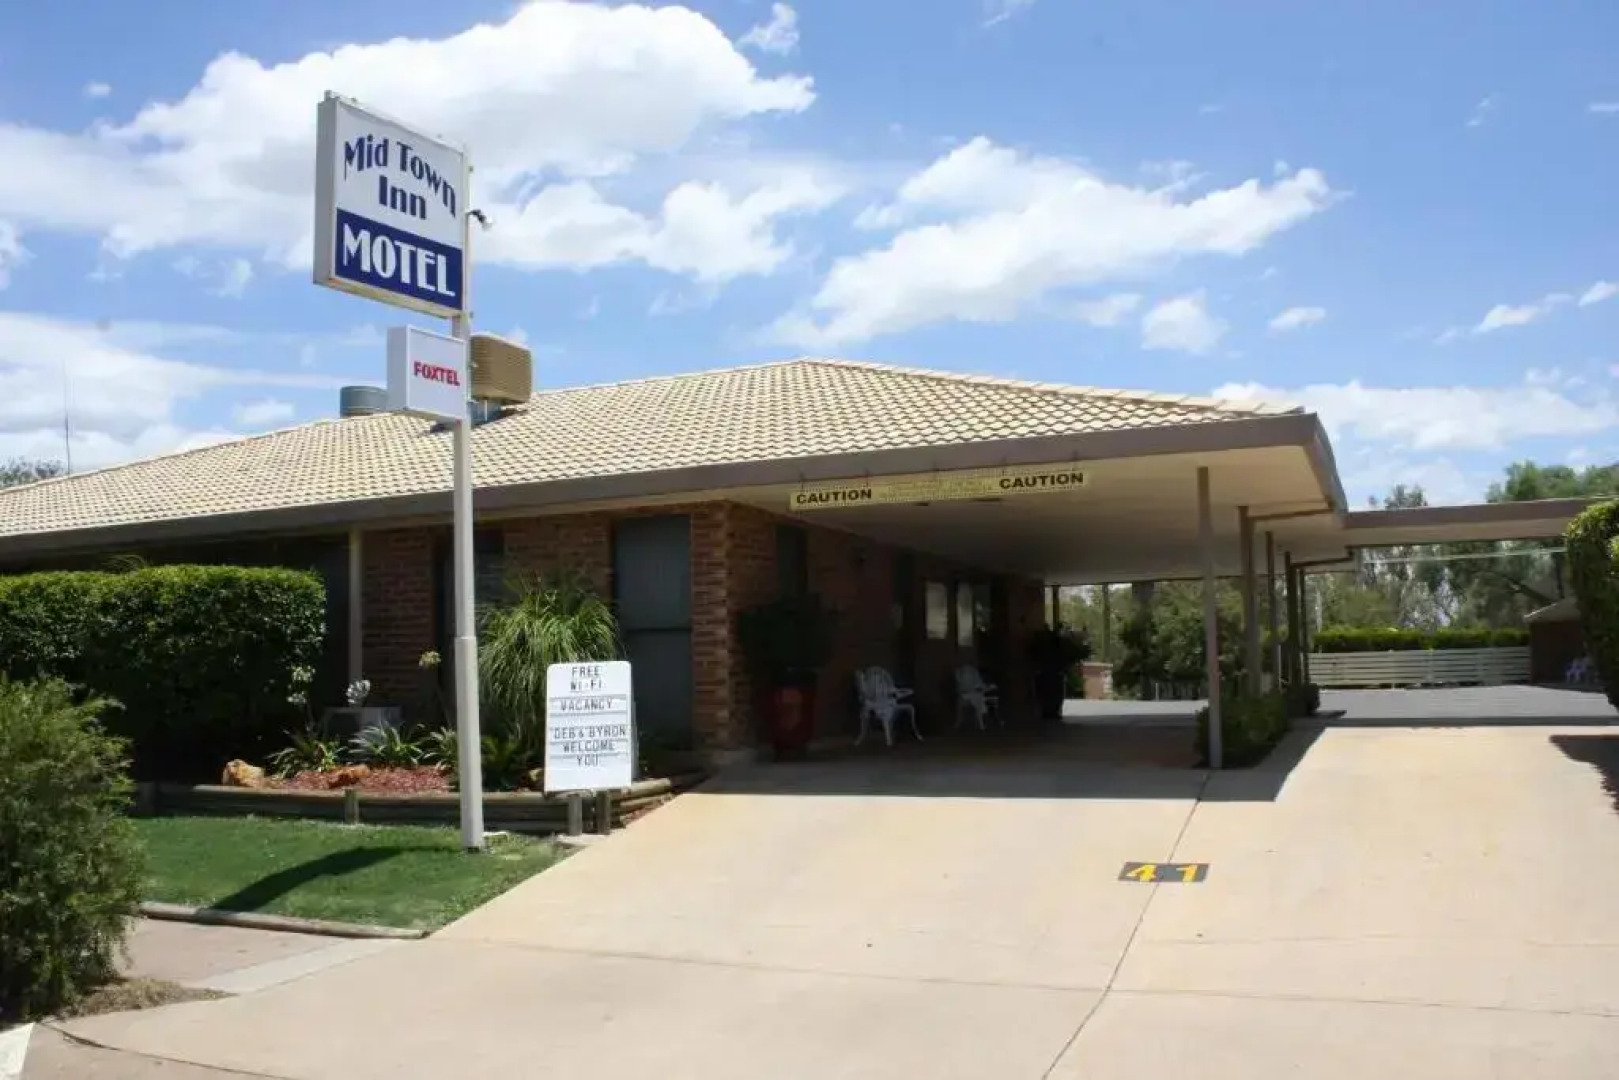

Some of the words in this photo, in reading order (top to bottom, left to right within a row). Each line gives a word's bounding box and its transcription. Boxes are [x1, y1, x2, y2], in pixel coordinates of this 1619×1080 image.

[344, 133, 389, 182] Mid
[397, 141, 456, 218] Town
[379, 174, 426, 221] Inn
[343, 222, 456, 297] MOTEL
[413, 361, 460, 387] FOXTEL
[796, 488, 872, 505] CAUTION
[999, 472, 1084, 490] CAUTION
[571, 665, 600, 677] FREE
[560, 699, 613, 711] VACANCY
[562, 740, 614, 753] WELCOME
[576, 754, 599, 767] YOU
